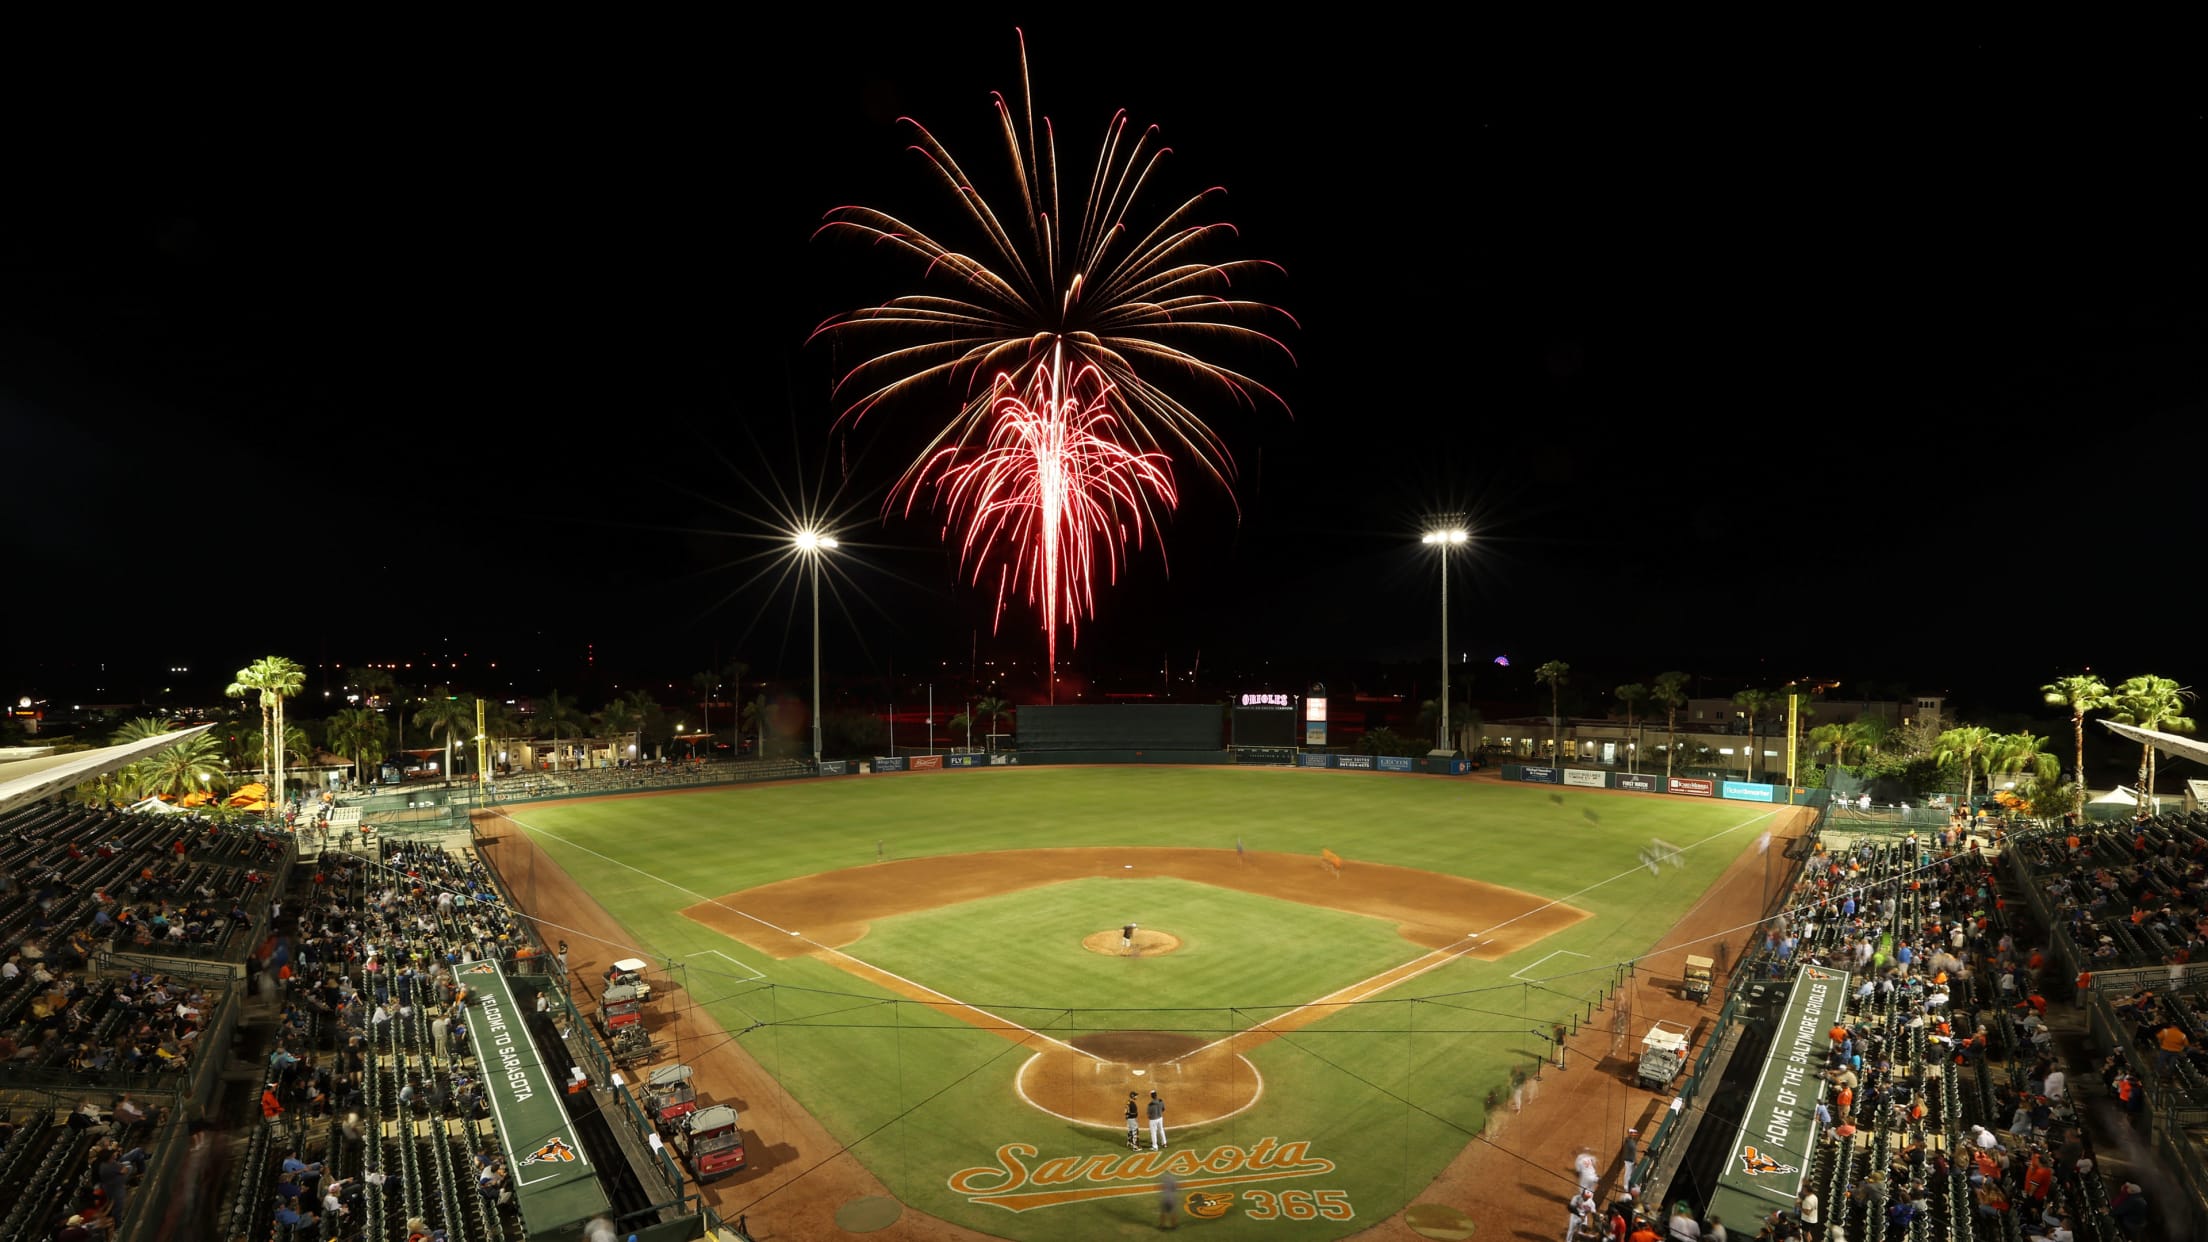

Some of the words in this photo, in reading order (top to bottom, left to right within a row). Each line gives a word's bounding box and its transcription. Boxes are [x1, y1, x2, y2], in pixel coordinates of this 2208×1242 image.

[1242, 694, 1288, 706] ORIOLES
[480, 993, 506, 1032] WELCOME
[1806, 984, 1828, 1017] ORIOLES
[494, 1031, 512, 1046] TO
[1790, 1015, 1819, 1064] BALTIMORE
[498, 1046, 533, 1103] SARASOTA
[1782, 1065, 1805, 1087] THE
[1777, 1087, 1799, 1105] OF
[1764, 1106, 1793, 1147] HOME
[947, 1137, 1336, 1194] Sarasota
[1242, 1190, 1356, 1222] 365
